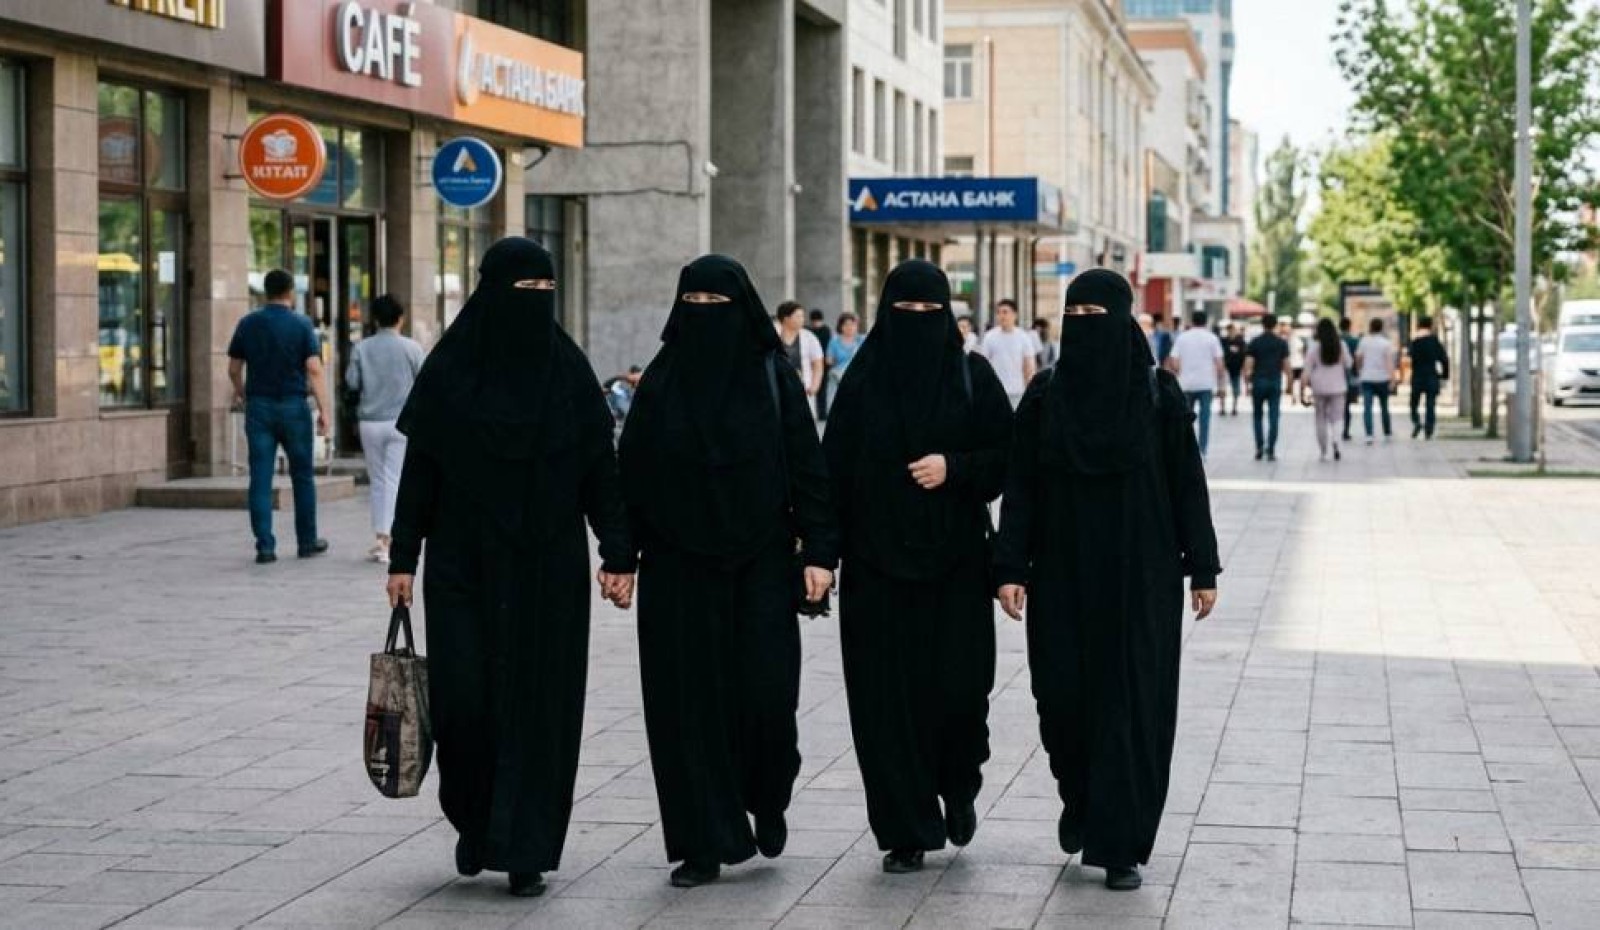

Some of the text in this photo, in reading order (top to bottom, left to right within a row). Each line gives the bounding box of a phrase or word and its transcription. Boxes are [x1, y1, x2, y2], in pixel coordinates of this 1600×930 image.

[338, 1, 421, 87] CAFÉ
[884, 190, 1015, 208] АСТАНА БАНК
